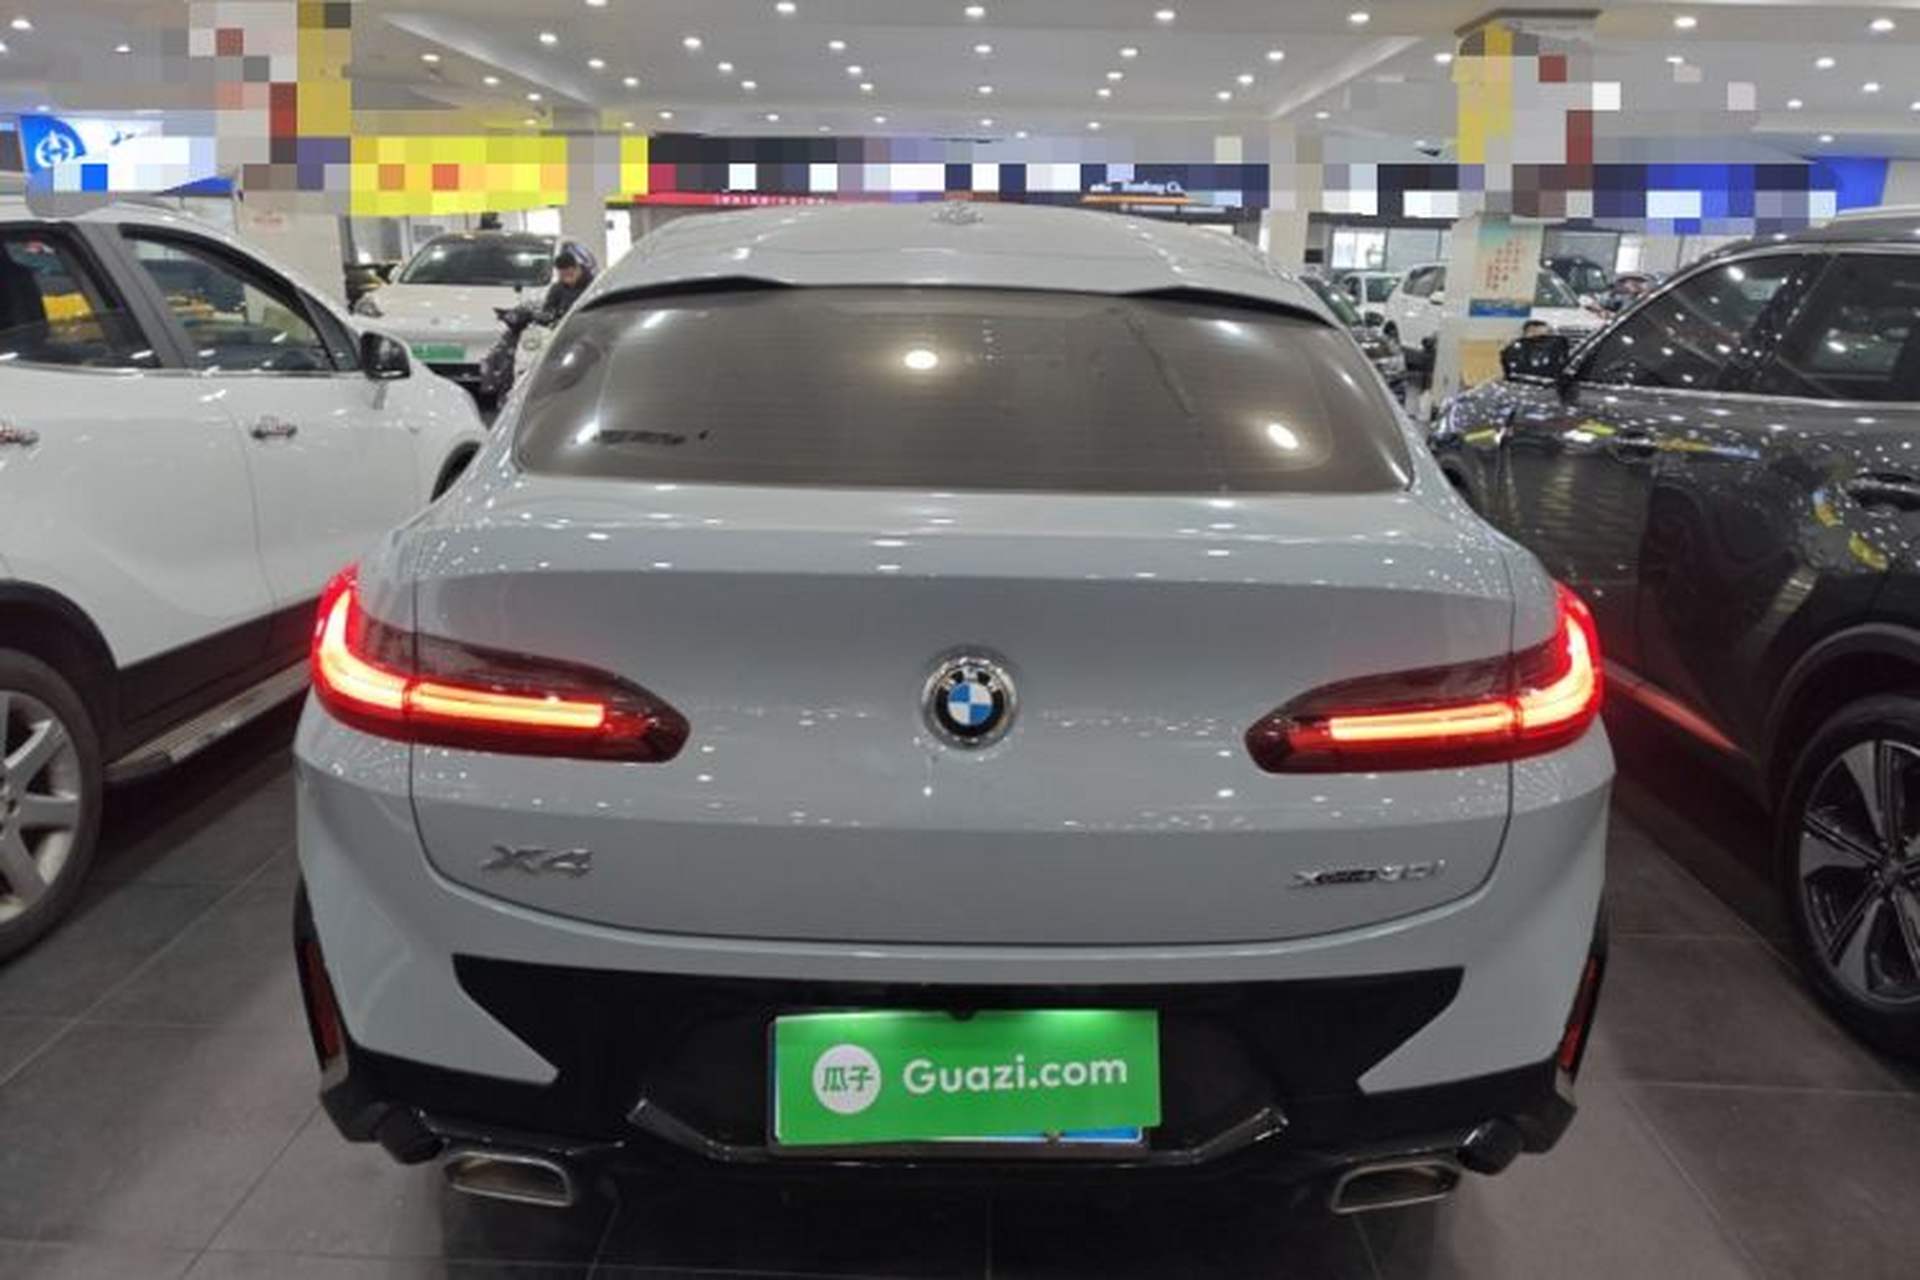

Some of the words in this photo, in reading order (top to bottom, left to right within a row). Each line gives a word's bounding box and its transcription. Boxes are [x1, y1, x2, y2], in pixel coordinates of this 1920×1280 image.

[482, 843, 592, 878] X4
[823, 1066, 874, 1092] 瓜子
[903, 1054, 1127, 1094] Guazi.com
